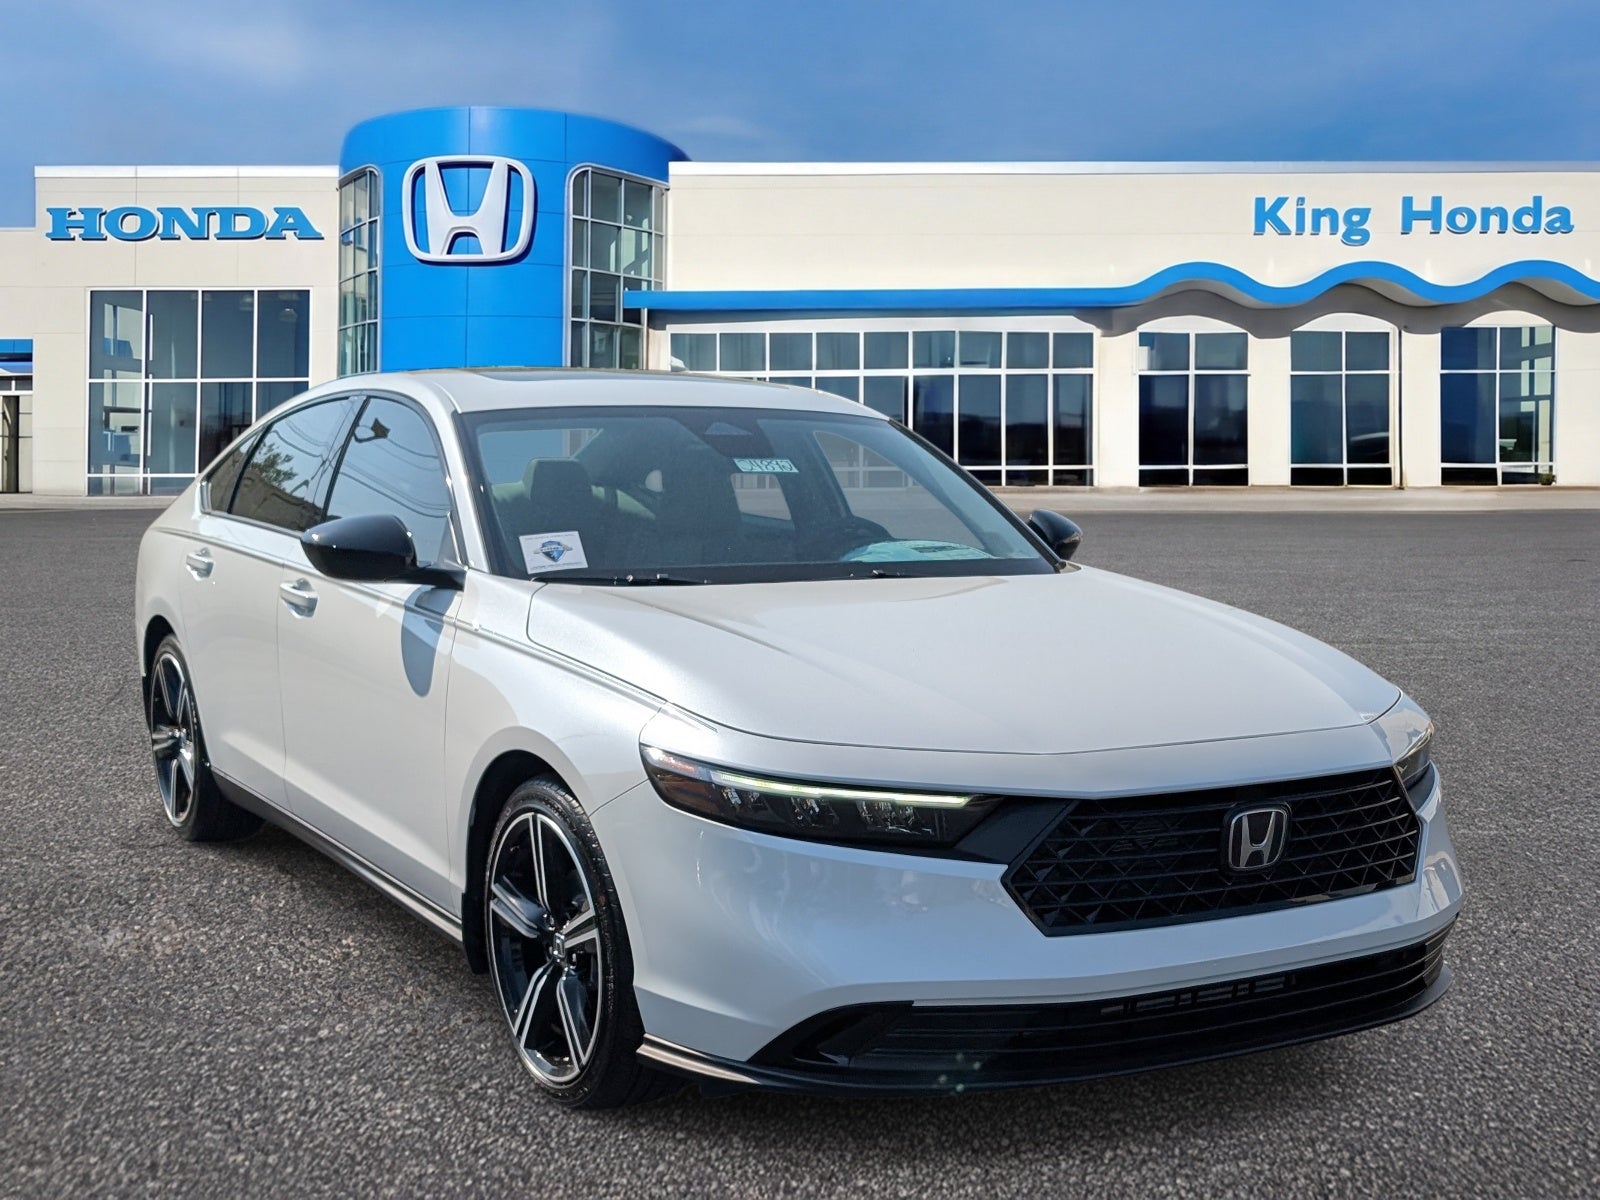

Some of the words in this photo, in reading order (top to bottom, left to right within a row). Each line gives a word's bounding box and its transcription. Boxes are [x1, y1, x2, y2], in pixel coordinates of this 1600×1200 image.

[45, 206, 325, 241] HONDA
[1253, 196, 1372, 246] King
[1401, 195, 1575, 235] Honda
